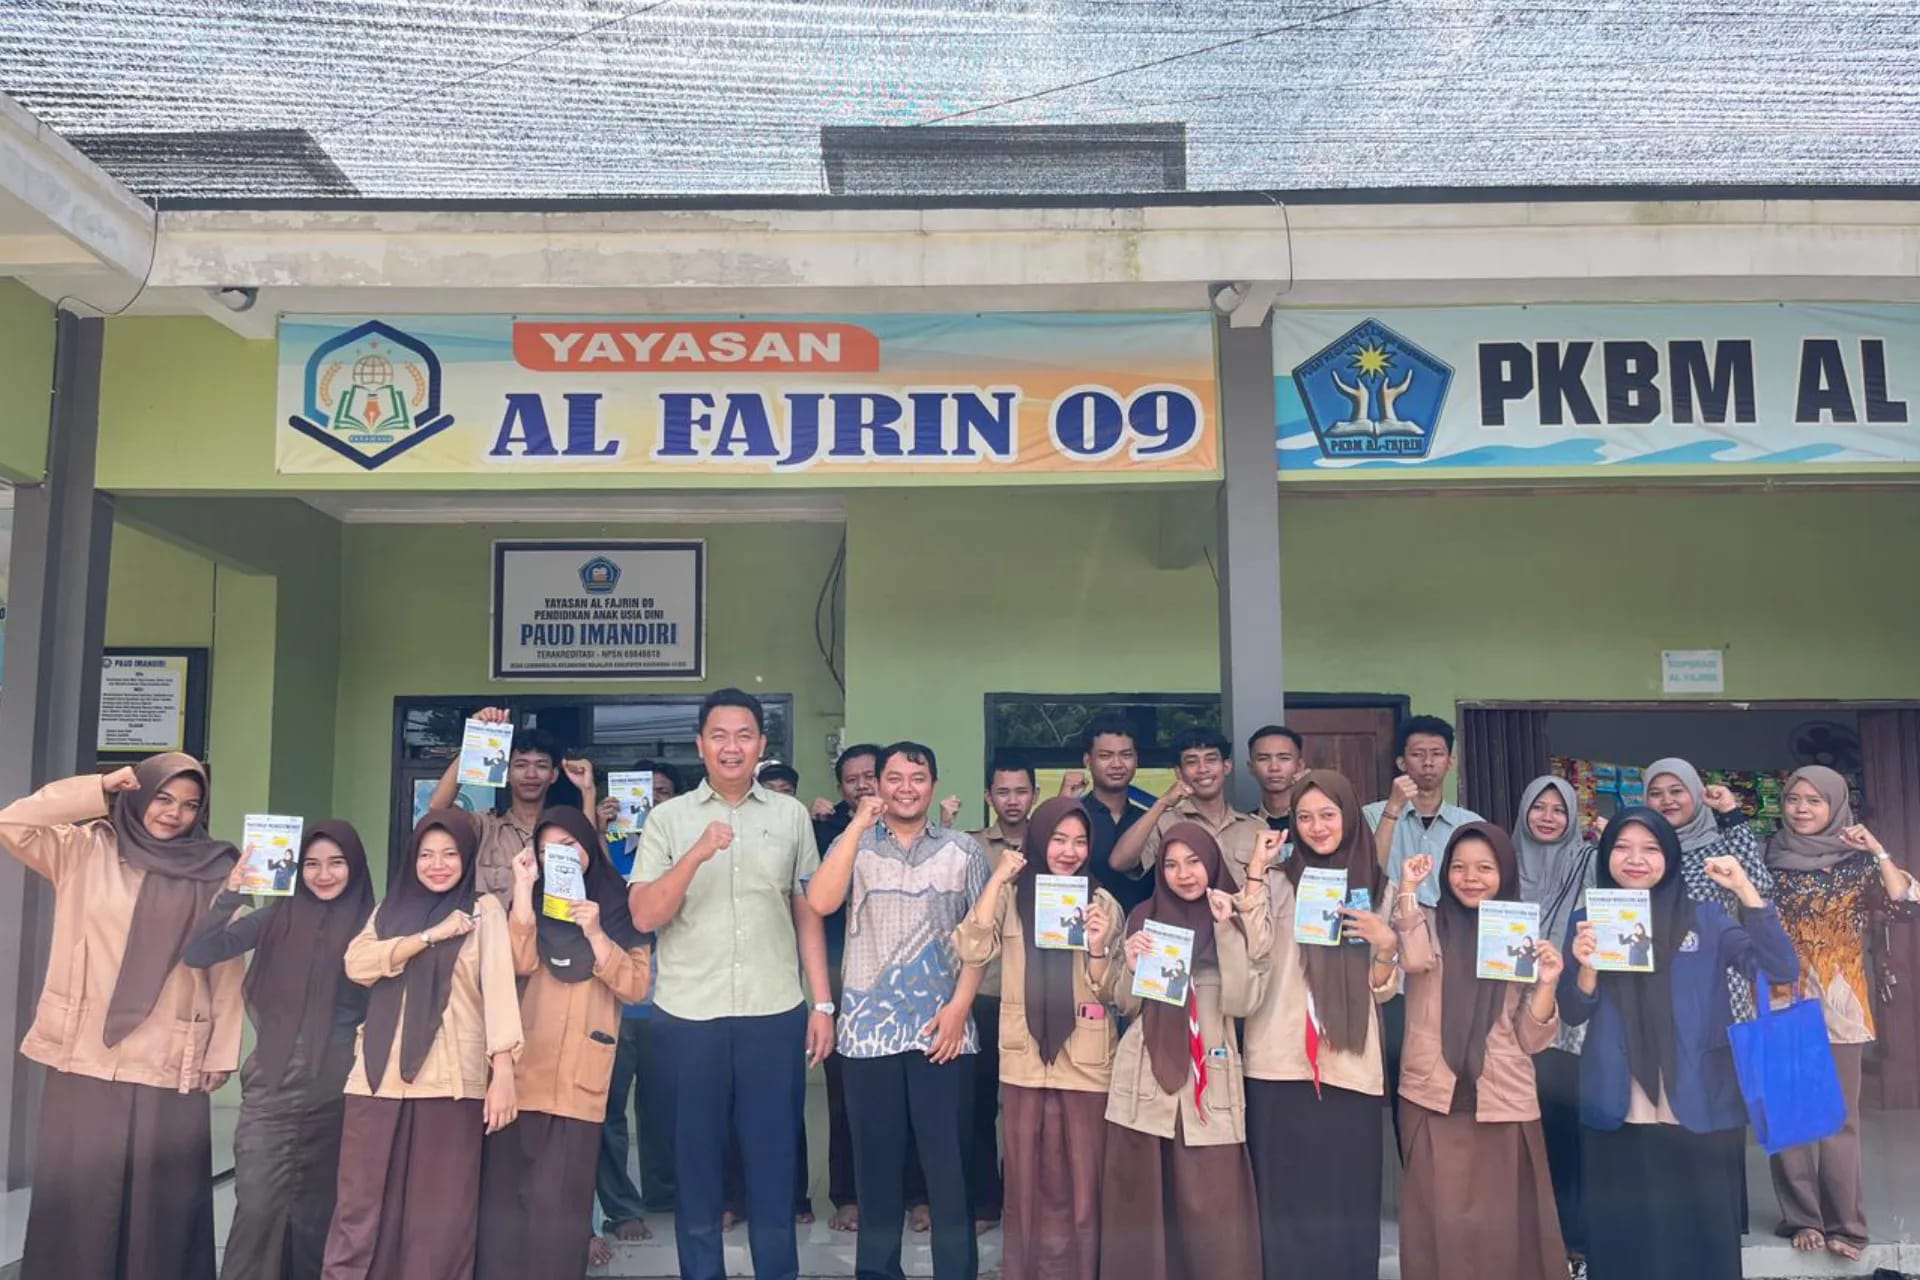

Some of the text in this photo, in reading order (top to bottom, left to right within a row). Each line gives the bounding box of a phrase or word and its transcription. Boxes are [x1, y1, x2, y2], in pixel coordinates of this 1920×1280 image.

[540, 332, 842, 363] YAYASAN
[1478, 339, 1757, 427] PKBM
[1794, 338, 1908, 424] AL
[490, 390, 1197, 466] AL FAJRIN 09
[534, 609, 664, 620] PENDIDIKAN ANAK USIA DINI
[544, 598, 655, 609] YAYASAN AL FAJRIN 09
[520, 622, 677, 646] PAUD IMANDIRI
